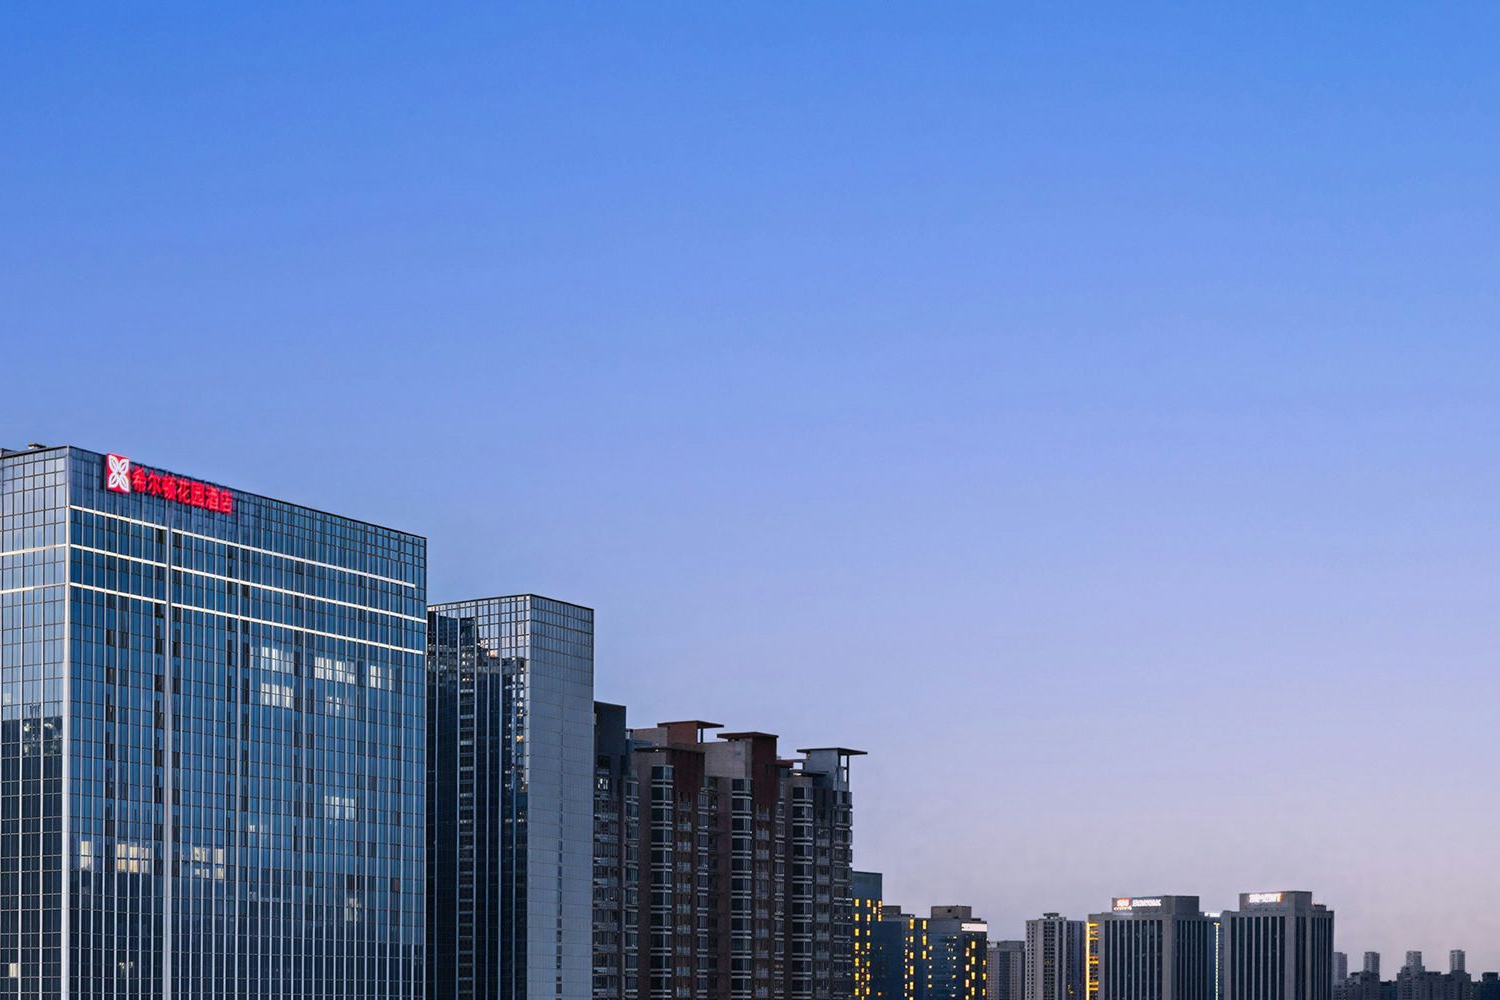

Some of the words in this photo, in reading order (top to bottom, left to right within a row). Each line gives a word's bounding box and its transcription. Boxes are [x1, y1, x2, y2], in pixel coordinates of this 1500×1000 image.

[131, 465, 232, 515] 希尔顿花园酒店
